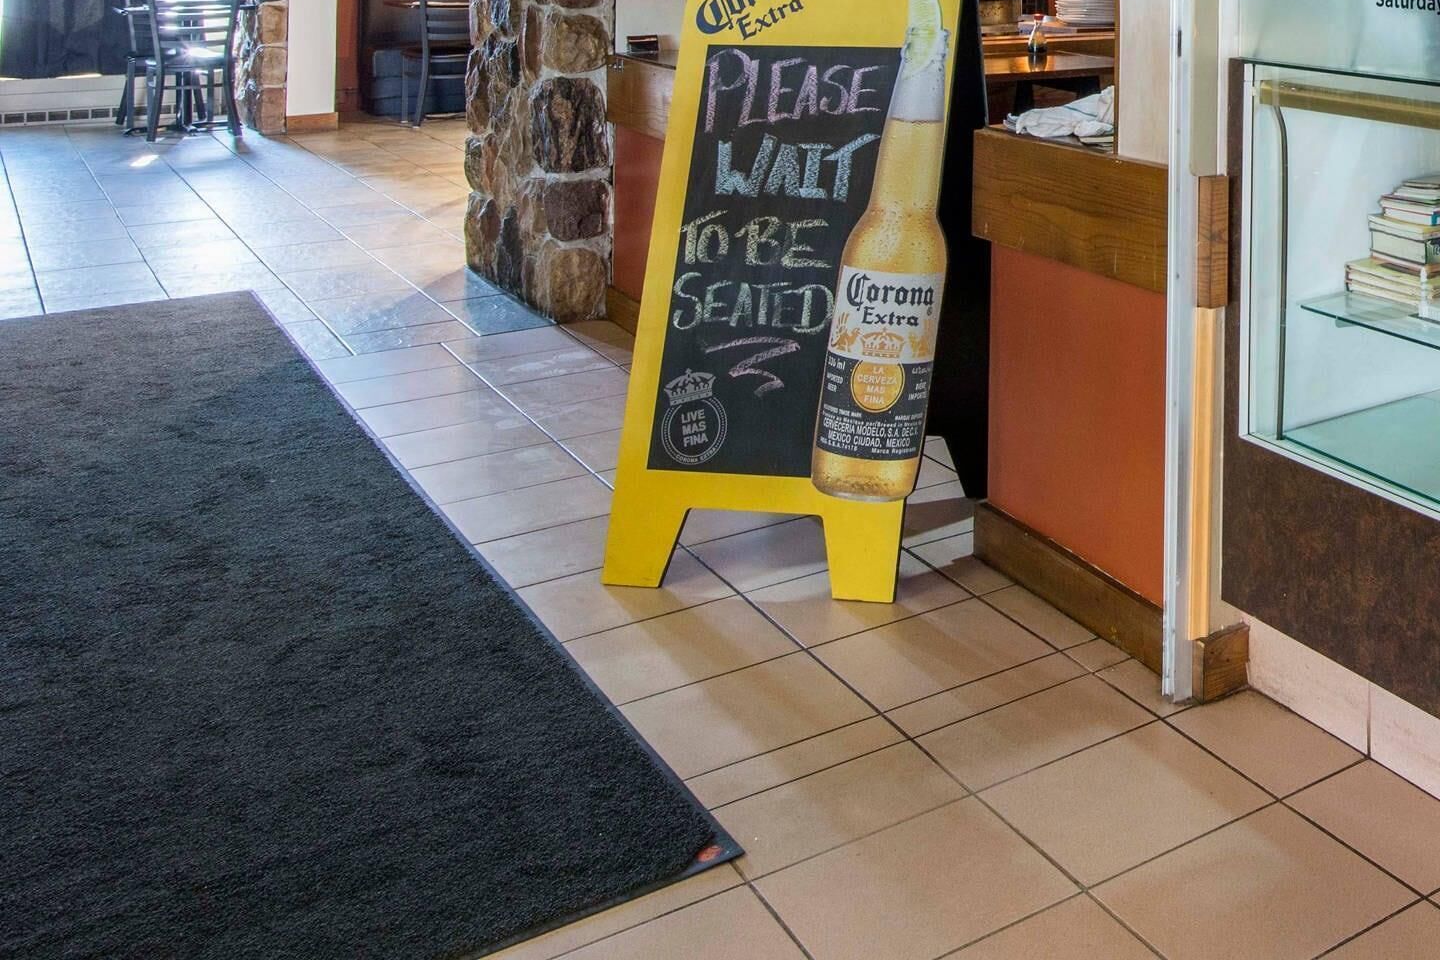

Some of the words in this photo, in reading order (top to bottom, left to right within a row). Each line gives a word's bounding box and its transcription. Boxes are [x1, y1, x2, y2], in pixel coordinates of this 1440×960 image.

[705, 48, 884, 133] PLEASE
[714, 133, 880, 203] WAIT
[679, 210, 728, 265] TO
[735, 215, 832, 269] BE
[846, 272, 935, 311] Corona
[673, 271, 835, 334] SEATED
[861, 305, 919, 327] Extra
[857, 374, 898, 384] CERVEZA
[873, 366, 885, 374] LA
[864, 395, 885, 405] FINA
[680, 408, 706, 424] LIVE
[682, 420, 707, 436] MAS
[823, 417, 855, 435] CERVECERIA
[683, 432, 709, 448] FINA
[828, 430, 851, 444] MEXICO
[886, 438, 911, 448] MEXICO
